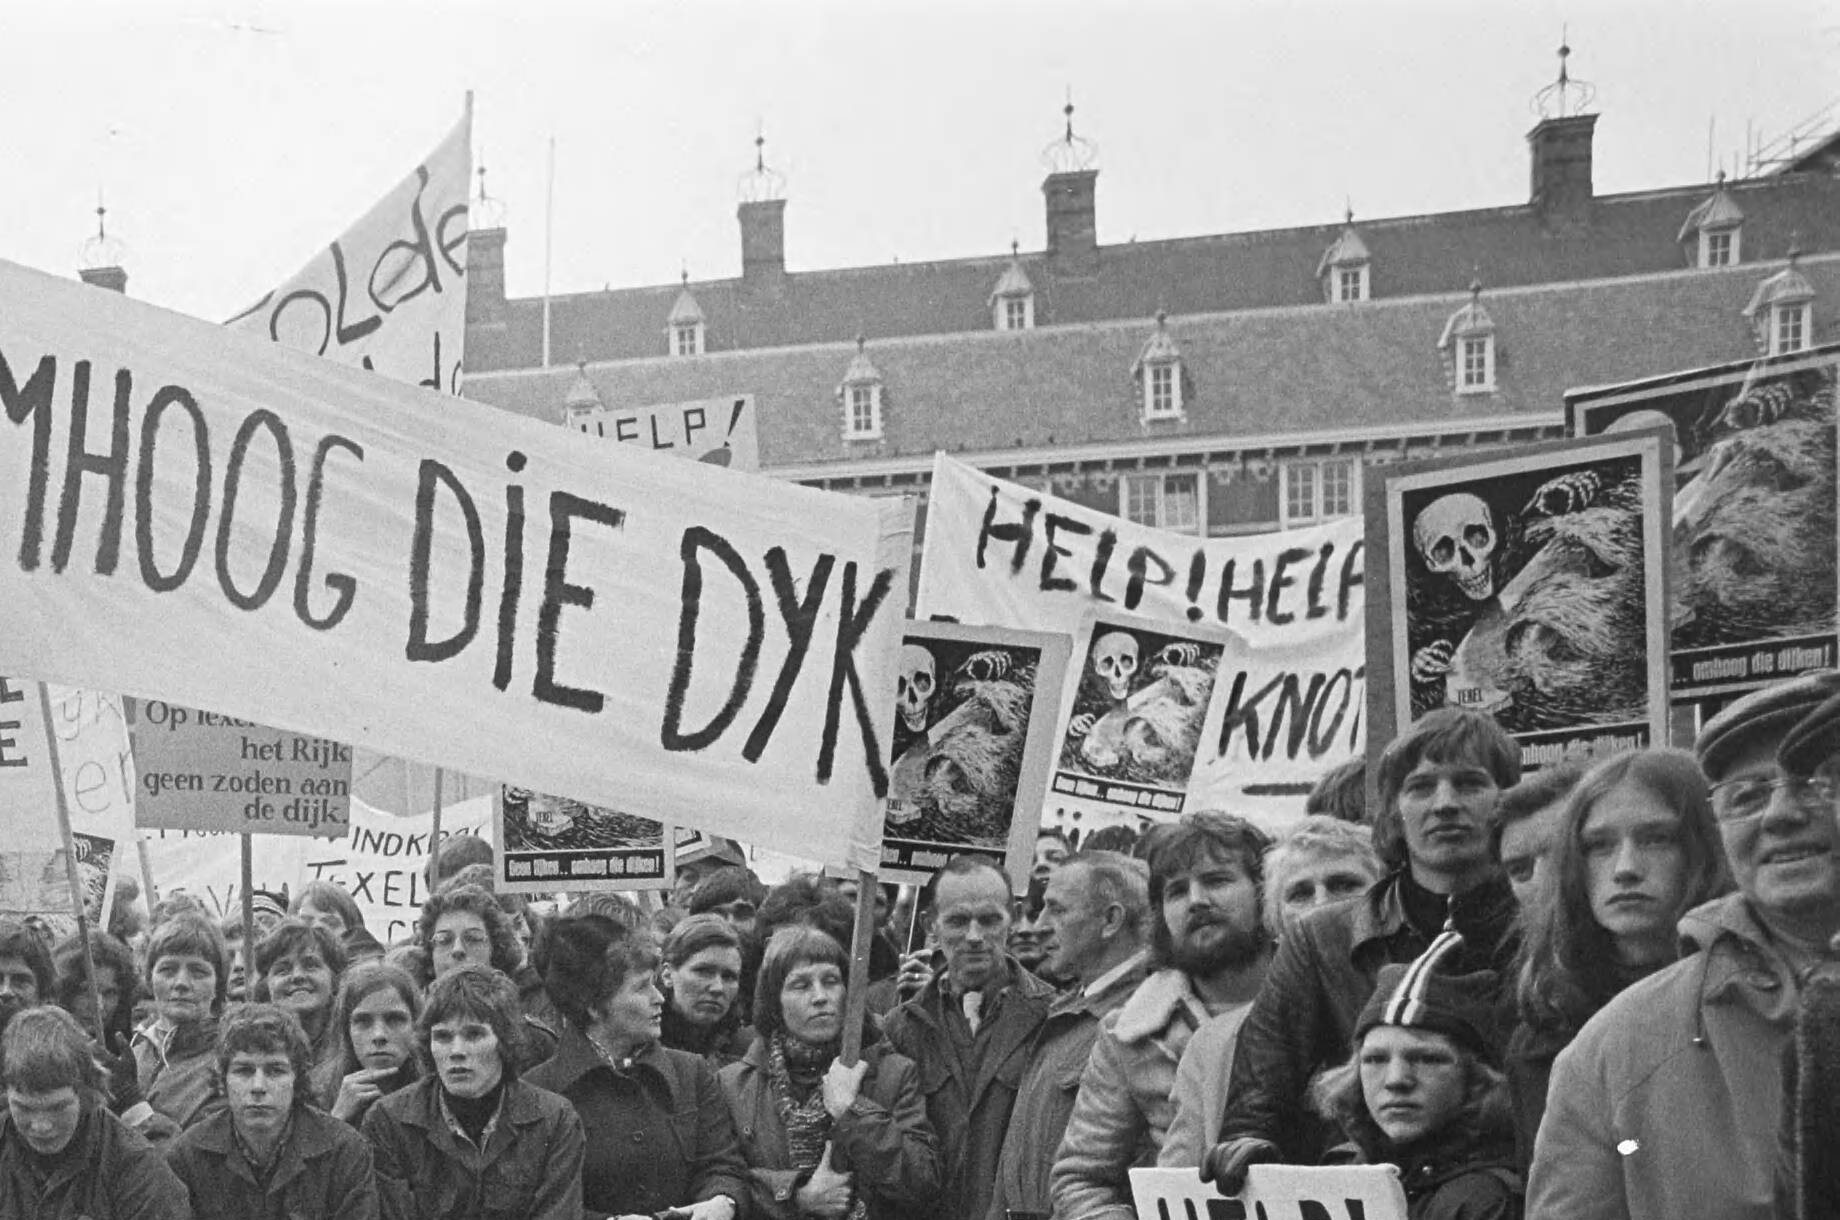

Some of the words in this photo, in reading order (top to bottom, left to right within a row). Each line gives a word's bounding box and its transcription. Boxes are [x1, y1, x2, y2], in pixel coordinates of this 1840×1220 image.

[661, 525, 894, 798] DYK
[1752, 652, 1774, 673] die
[146, 700, 187, 731] Op
[241, 736, 284, 761] het
[290, 738, 350, 769] Rijk
[143, 772, 203, 797] geen
[210, 770, 291, 794] zoden
[300, 777, 348, 796] aan
[244, 797, 274, 820] de
[282, 798, 348, 829] dijk.
